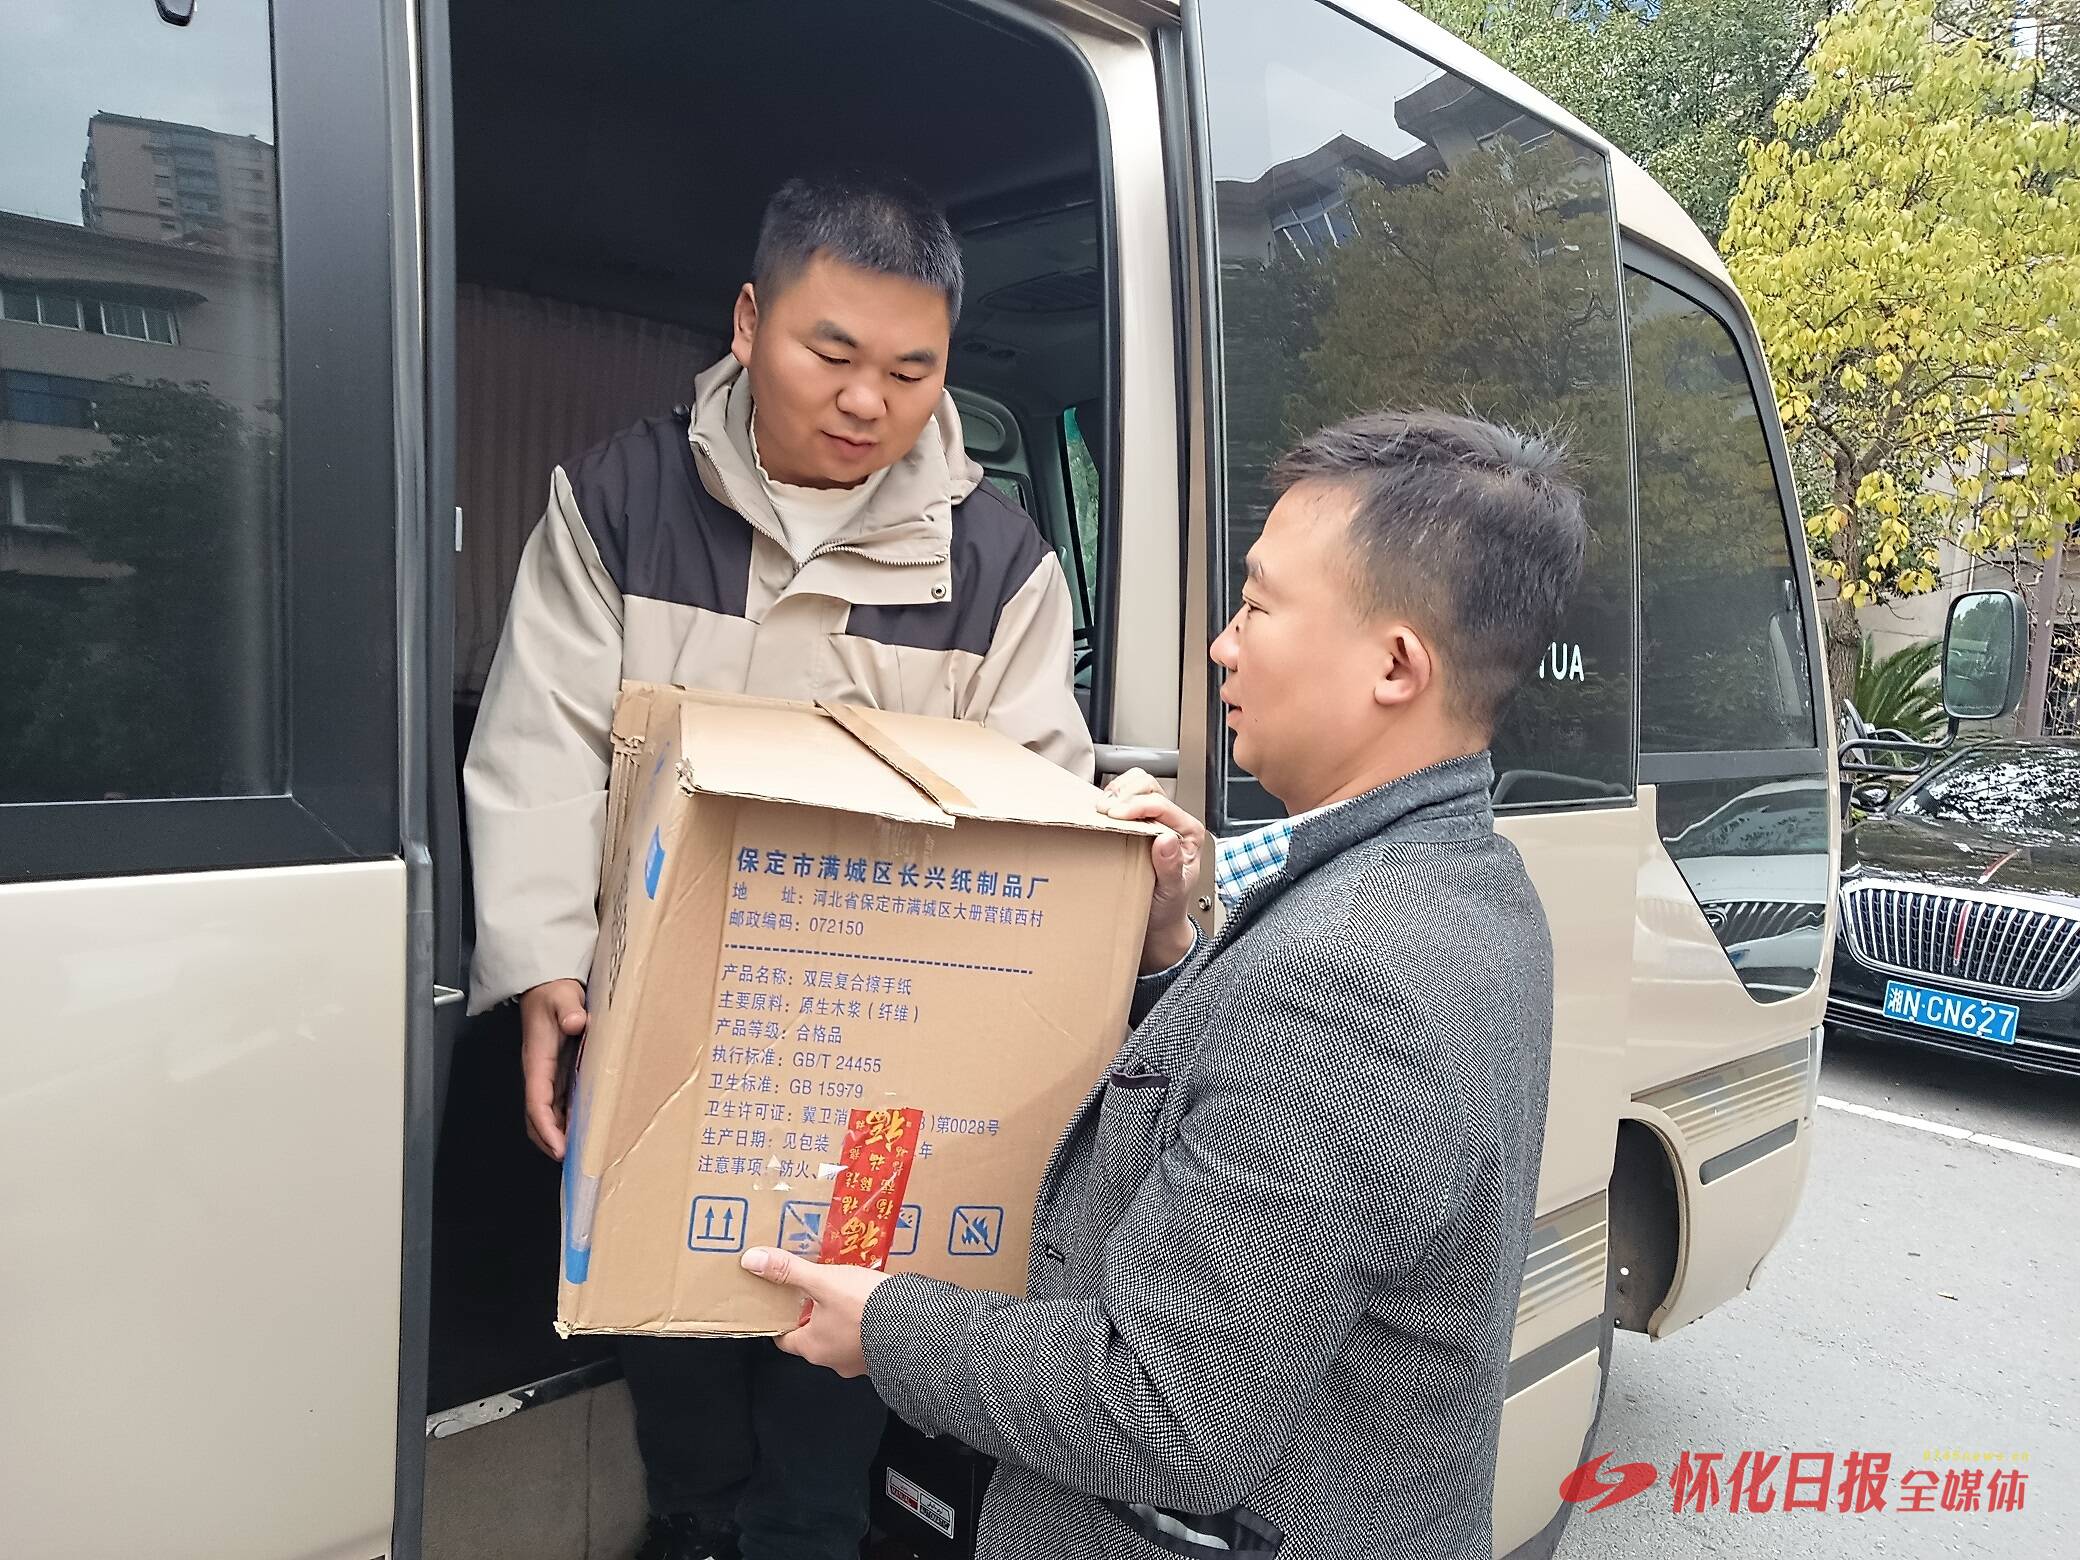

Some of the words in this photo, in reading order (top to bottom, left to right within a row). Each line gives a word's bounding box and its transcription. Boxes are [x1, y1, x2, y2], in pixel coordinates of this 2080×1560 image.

[737, 846, 1049, 899] 保定市满城区长兴纸制品厂
[865, 1110, 905, 1152] 福
[840, 1216, 880, 1261] 福
